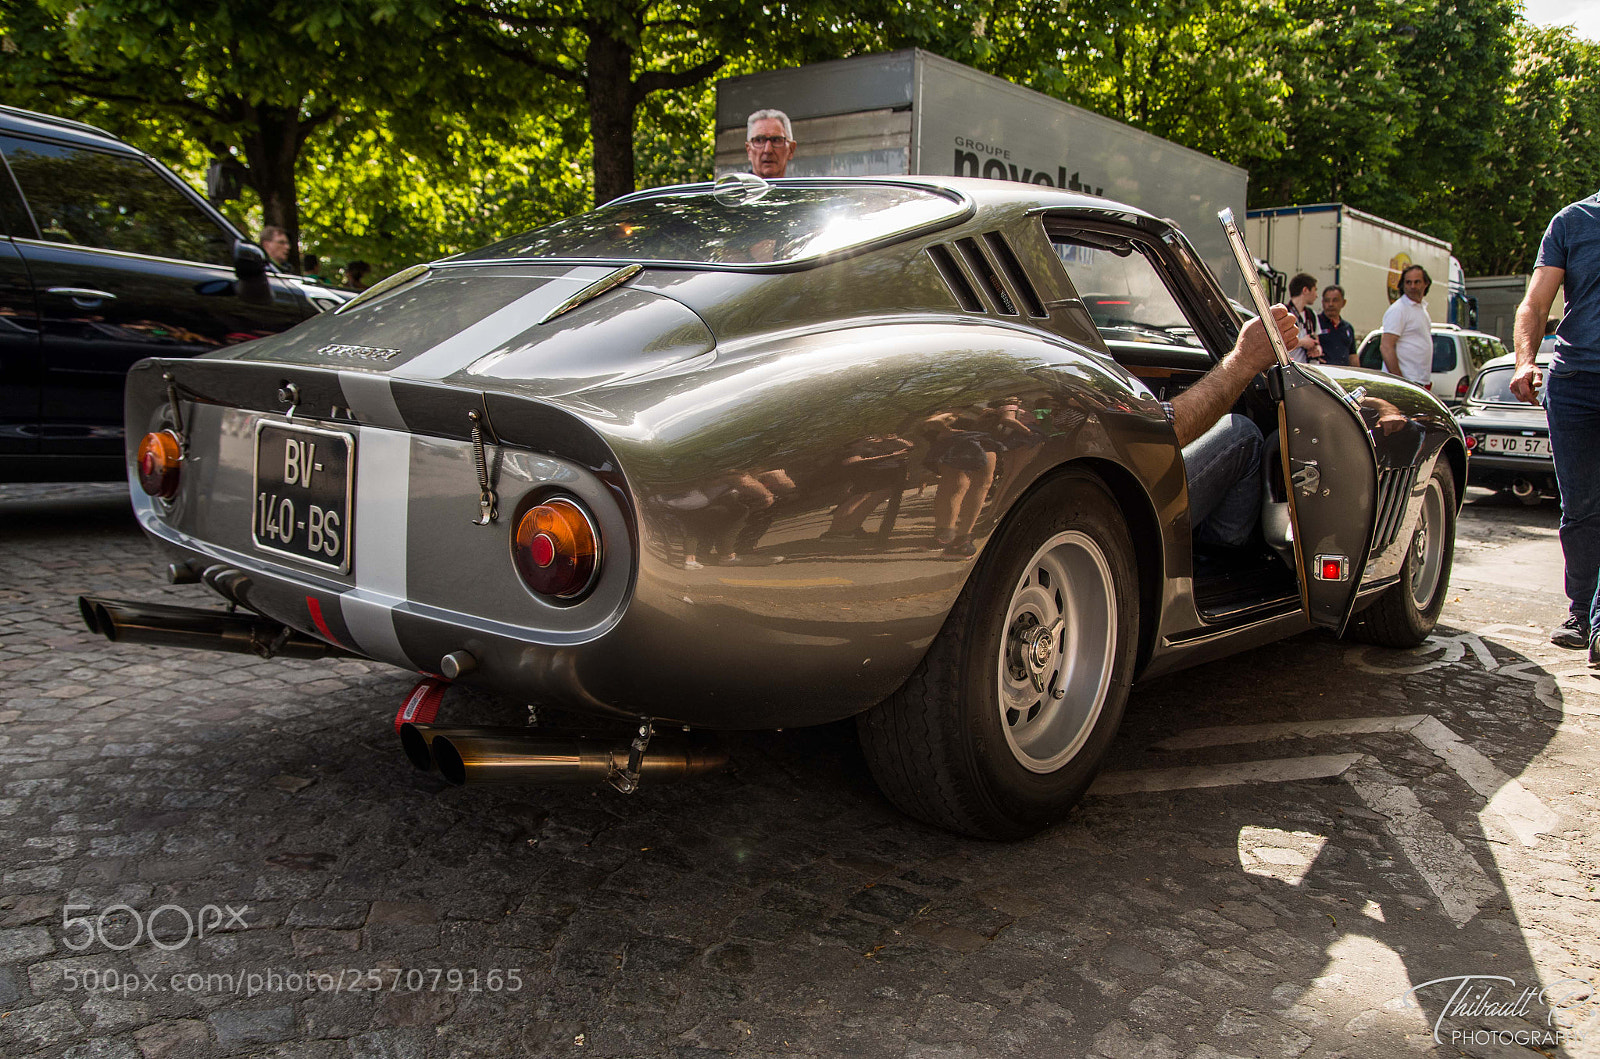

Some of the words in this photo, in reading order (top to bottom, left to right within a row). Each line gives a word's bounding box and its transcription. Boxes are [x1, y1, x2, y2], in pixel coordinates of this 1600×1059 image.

[954, 136, 1011, 160] GROUPE
[1502, 438, 1517, 450] VD
[1525, 440, 1541, 452] 57
[284, 438, 323, 489] BV-
